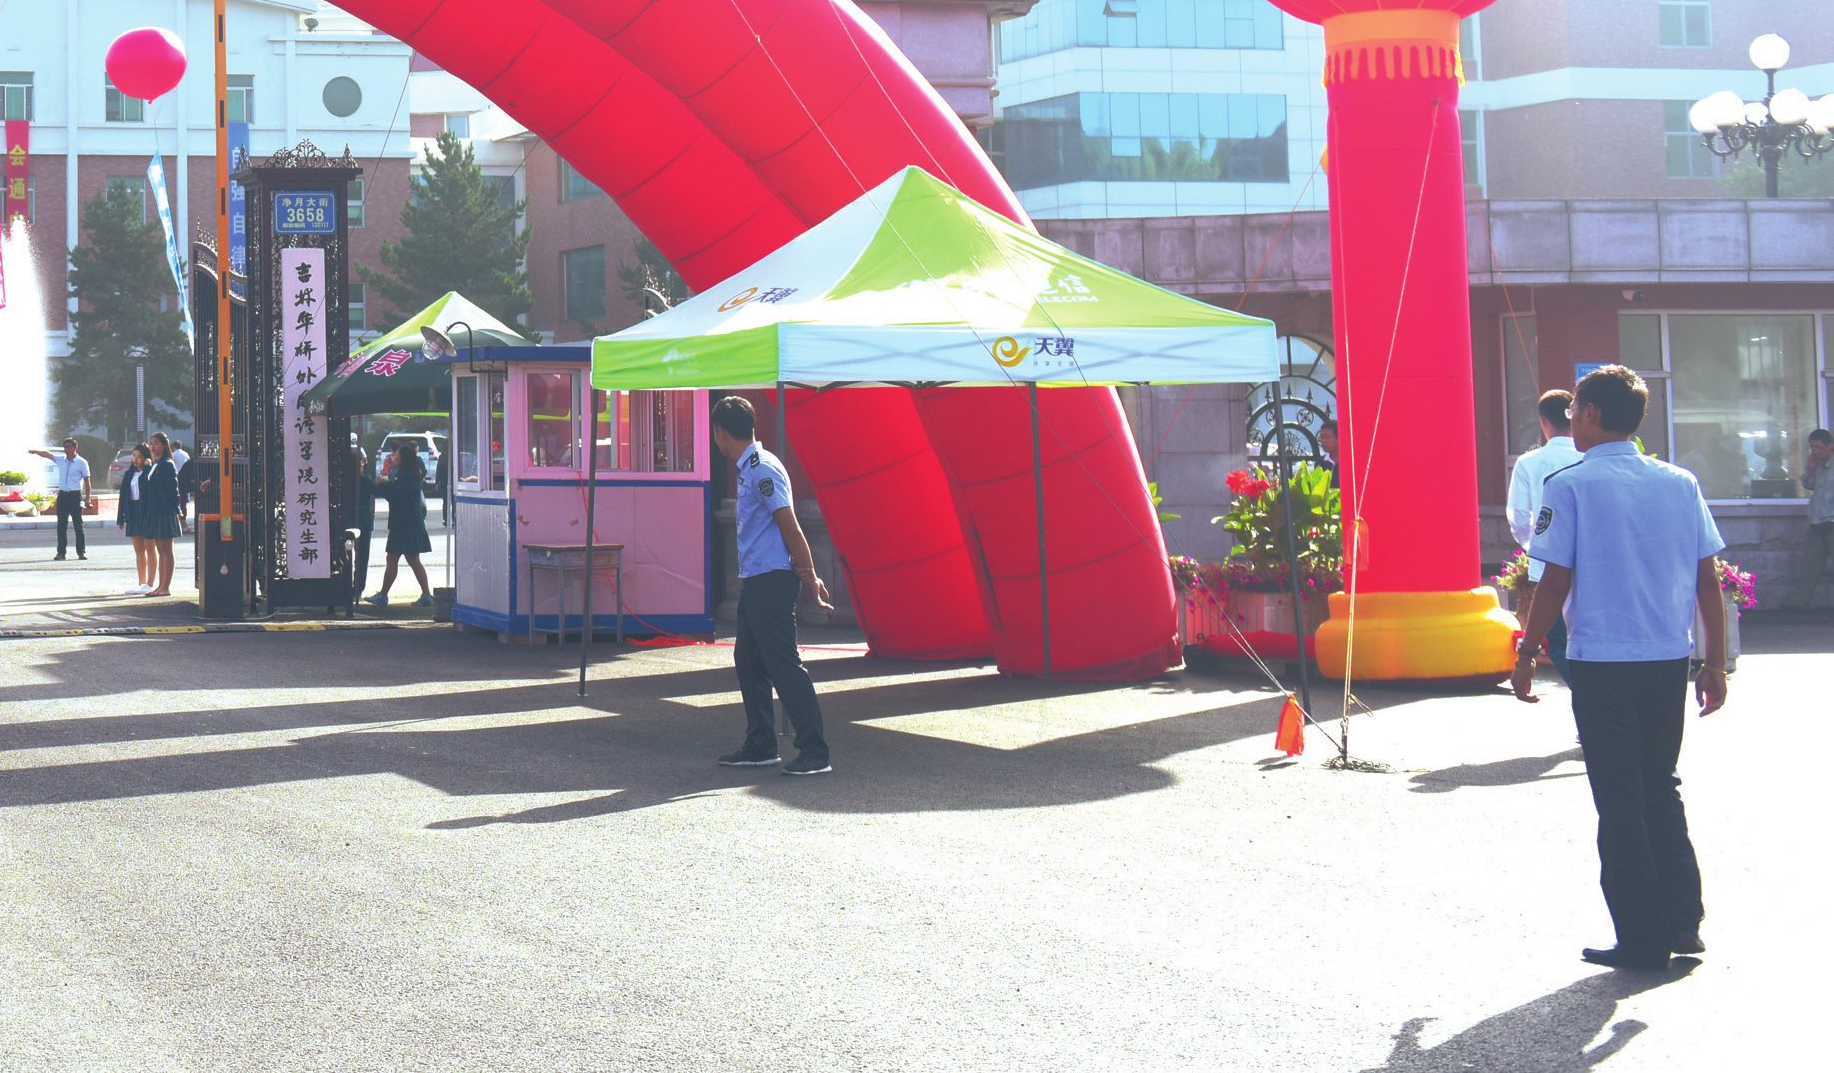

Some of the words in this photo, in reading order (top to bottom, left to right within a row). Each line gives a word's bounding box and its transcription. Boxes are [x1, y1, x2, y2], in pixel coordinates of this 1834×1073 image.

[9, 145, 26, 225] 会通
[282, 197, 328, 206] 净月大街
[287, 208, 324, 222] 3658
[1033, 337, 1075, 357] 天翼
[364, 349, 413, 377] 泉
